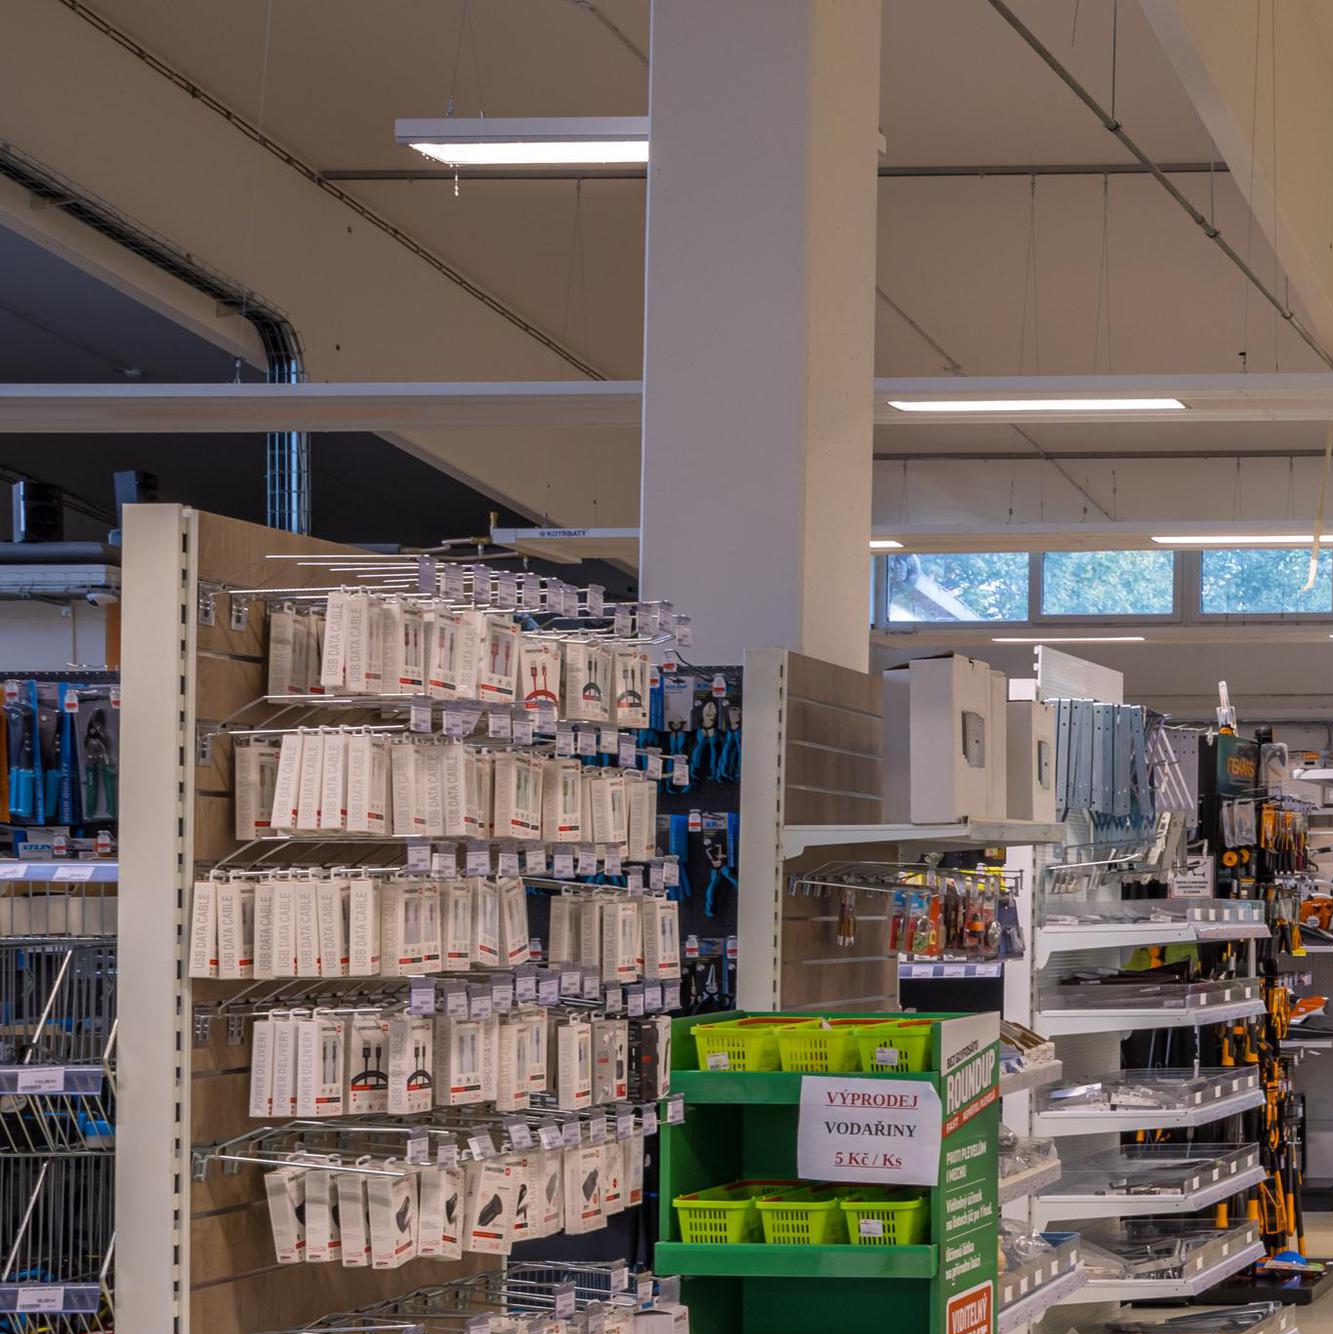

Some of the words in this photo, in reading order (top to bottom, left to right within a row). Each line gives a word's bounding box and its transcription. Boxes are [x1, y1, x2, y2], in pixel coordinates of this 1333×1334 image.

[946, 1048, 996, 1116] ROUNDUP
[827, 1089, 919, 1108] VÝPRODEJ
[825, 1121, 917, 1138] VODAŘINY
[835, 1152, 843, 1165] 5
[848, 1152, 869, 1166] Kč
[882, 1153, 902, 1167] Ks
